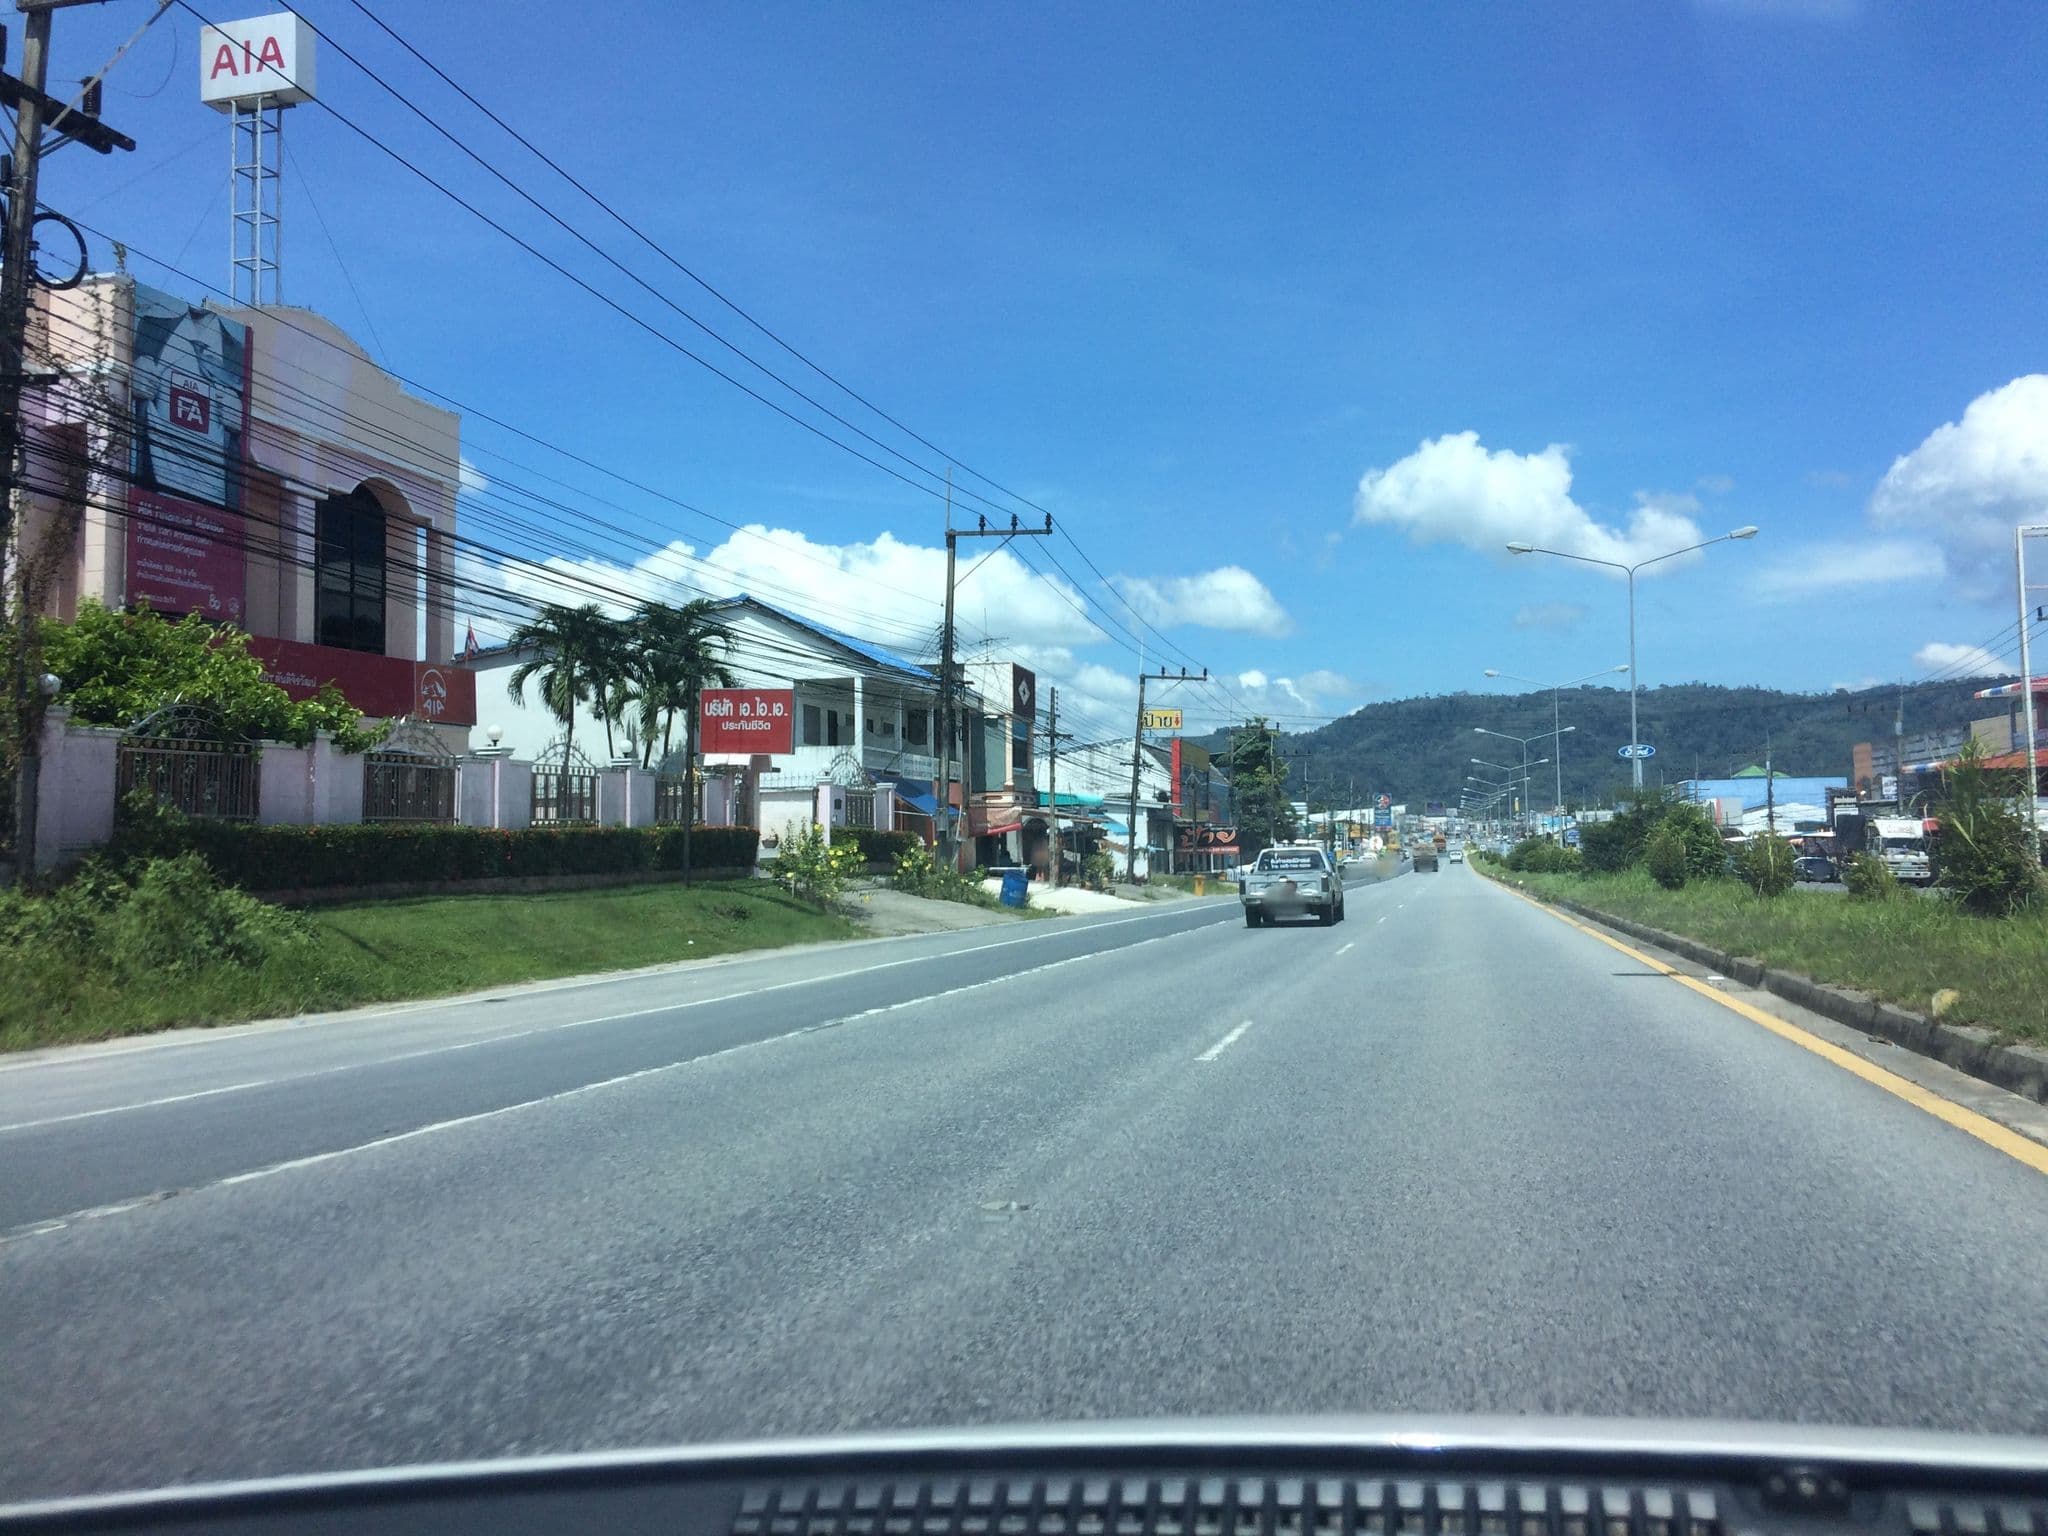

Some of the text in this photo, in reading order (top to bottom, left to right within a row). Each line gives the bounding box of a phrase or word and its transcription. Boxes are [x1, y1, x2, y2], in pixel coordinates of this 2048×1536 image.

[210, 36, 285, 80] AIA
[183, 379, 200, 391] AIA
[177, 396, 203, 425] FA
[423, 698, 446, 716] AIA
[704, 698, 734, 717] บริษัท
[721, 720, 771, 731] ประกันชีวิต
[1143, 710, 1173, 728] ป้าย
